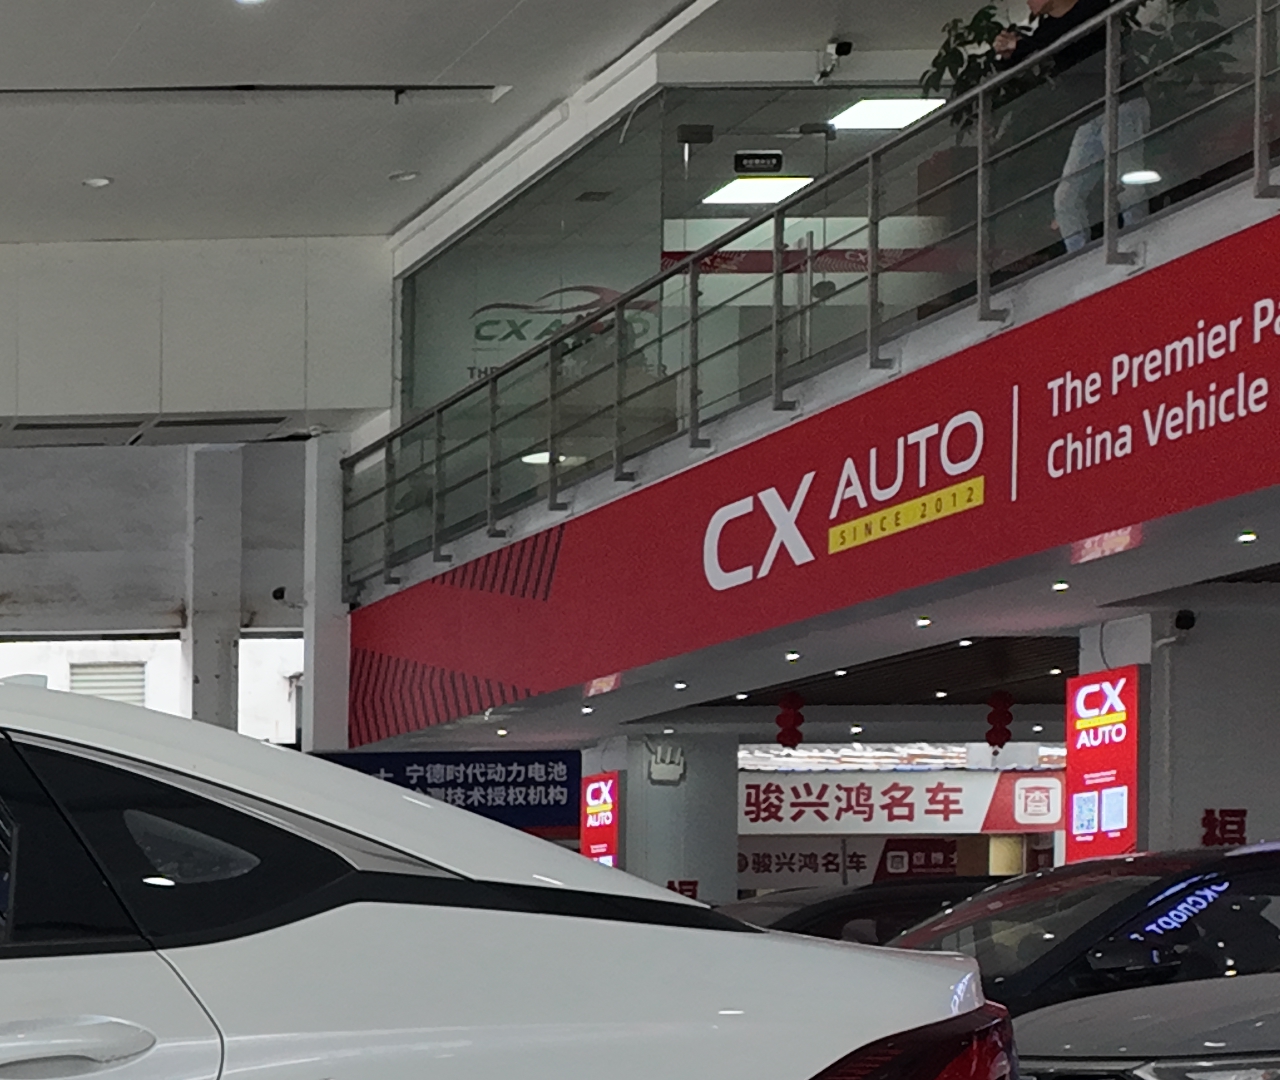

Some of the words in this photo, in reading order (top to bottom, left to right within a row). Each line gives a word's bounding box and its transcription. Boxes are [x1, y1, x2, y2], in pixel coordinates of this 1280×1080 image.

[1047, 370, 1102, 417] The
[1111, 316, 1242, 396] Premier
[1048, 425, 1132, 478] China
[1142, 372, 1269, 447] Vehicle
[703, 470, 816, 591] CX
[829, 410, 984, 520] AUTO
[839, 510, 902, 546] SINCE
[920, 486, 975, 519] 2012
[1074, 677, 1127, 718] CX
[1076, 723, 1127, 749] AUTO
[406, 762, 568, 784] 宁德时代动力电池
[586, 779, 614, 807] CX
[586, 811, 613, 827] AUTO
[744, 782, 964, 823] 骏兴鸿名车
[751, 851, 868, 874] 骏兴鸿名车
